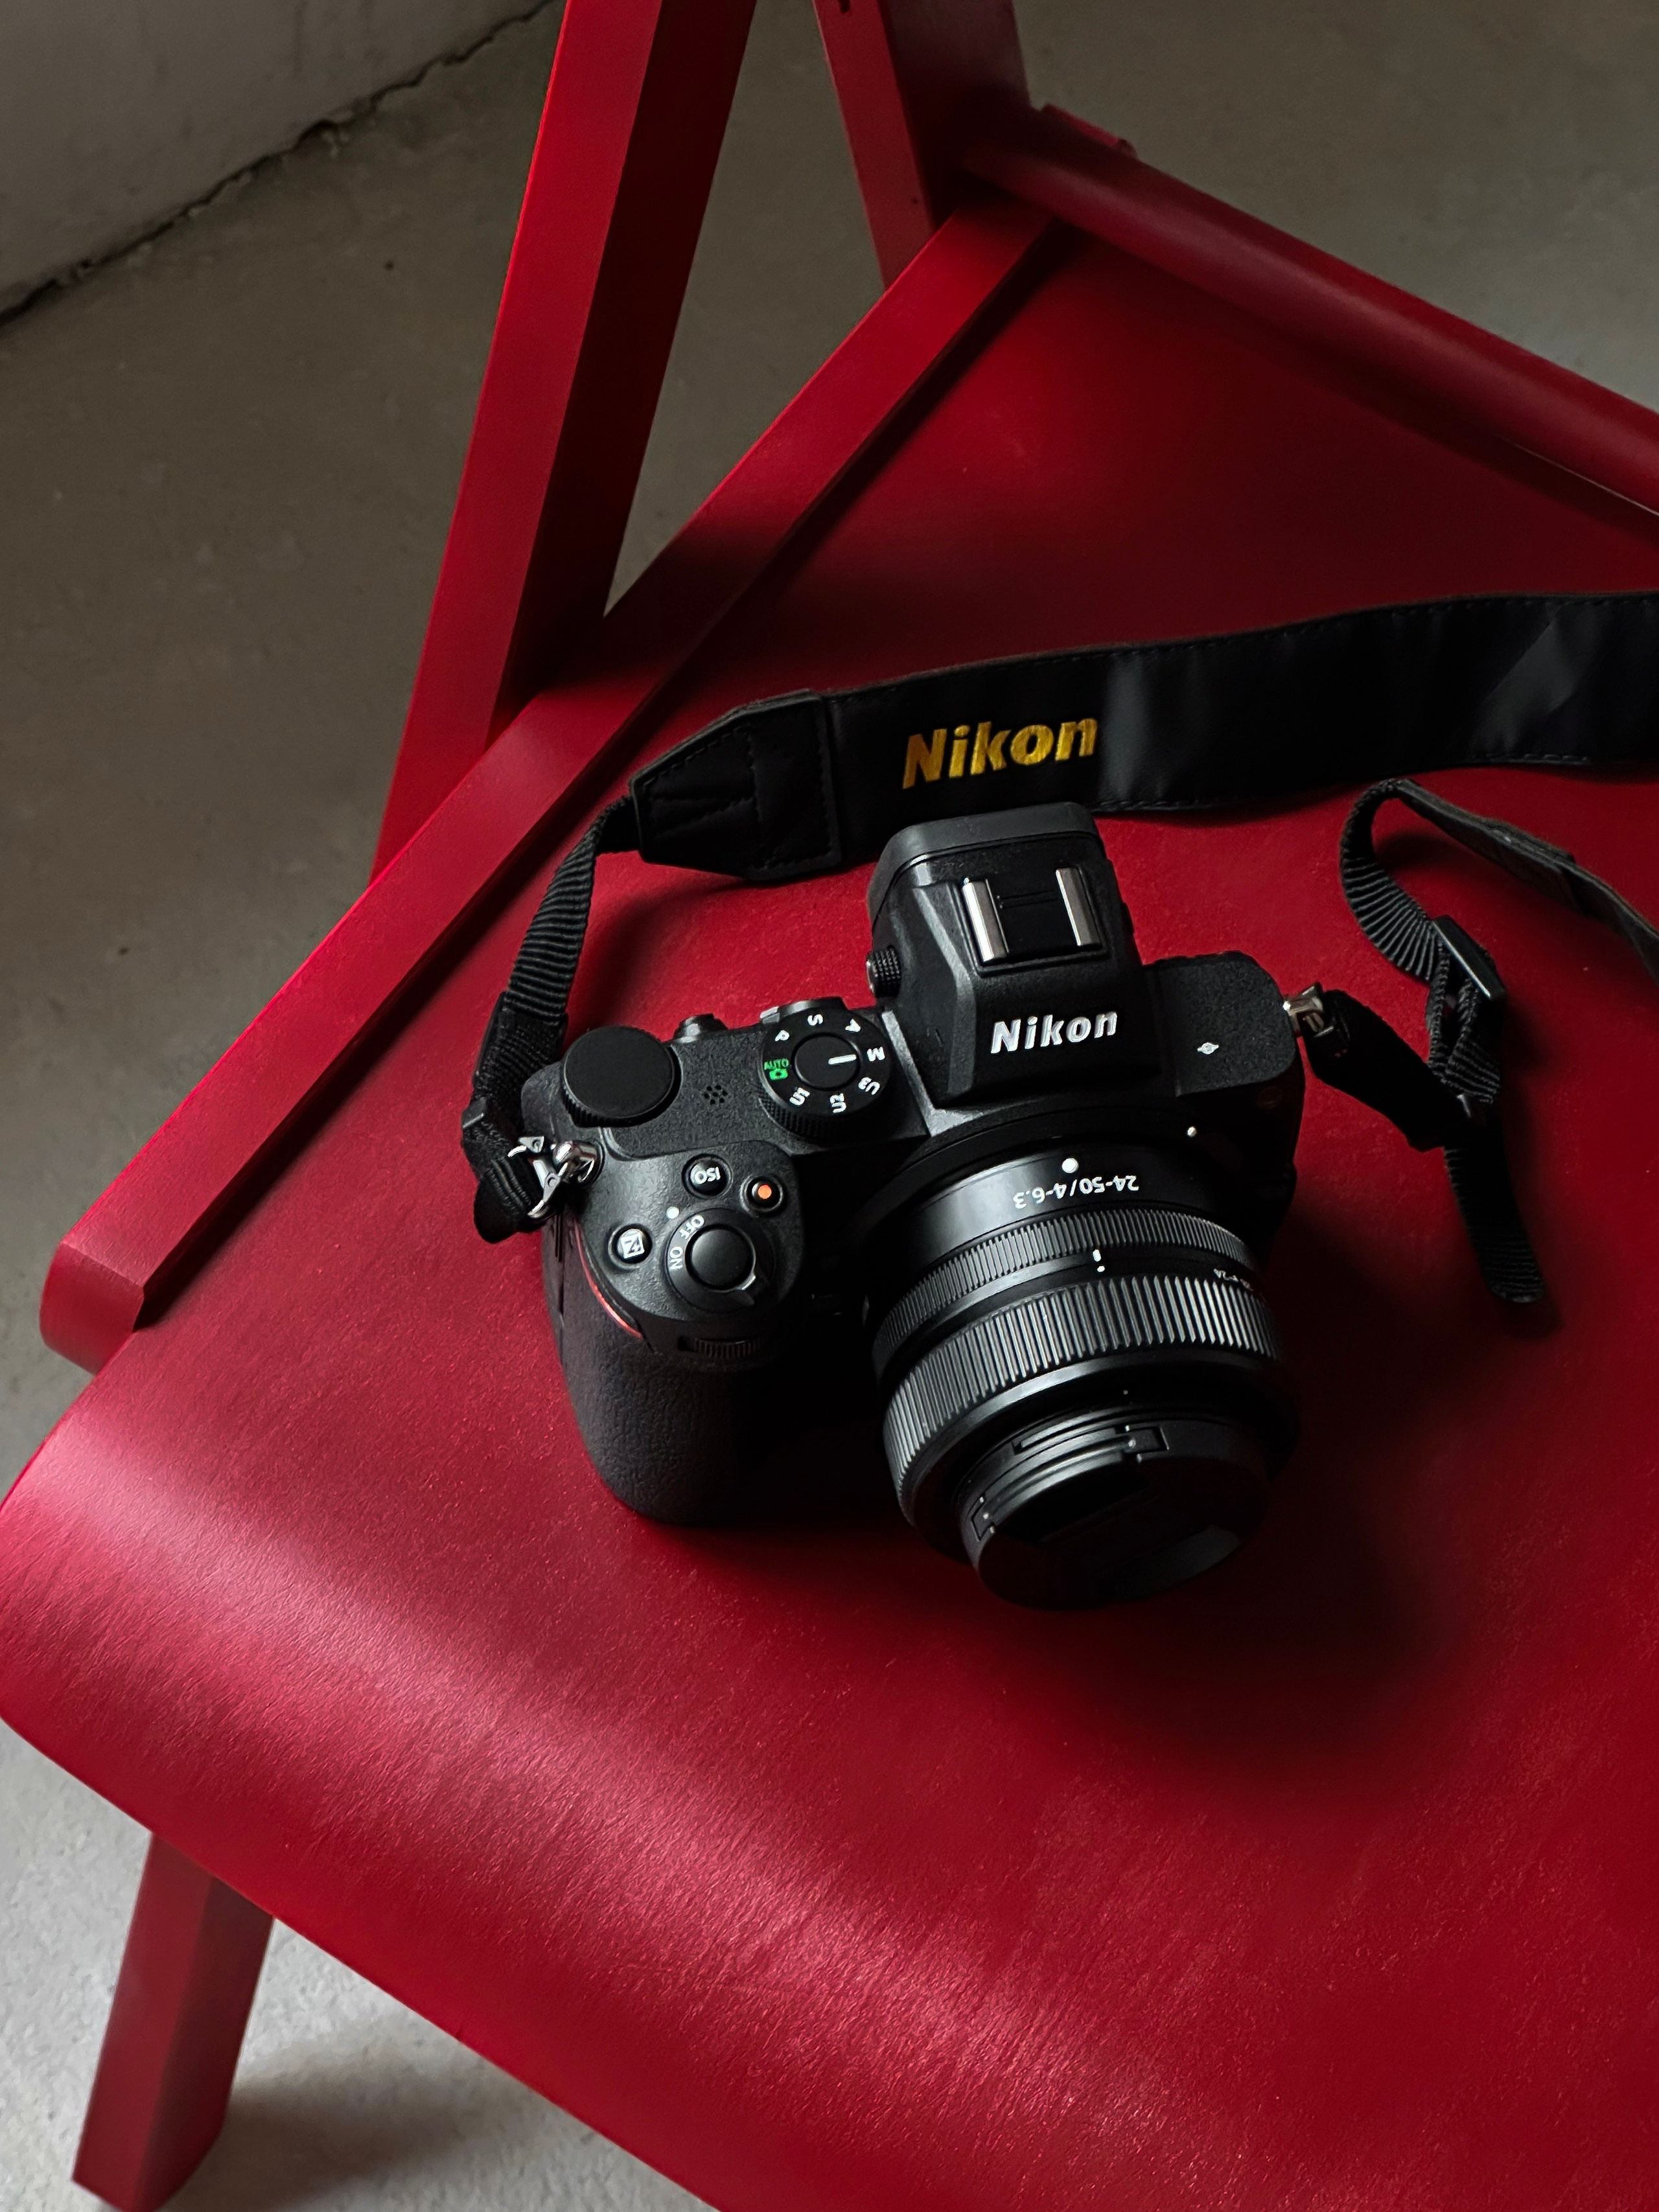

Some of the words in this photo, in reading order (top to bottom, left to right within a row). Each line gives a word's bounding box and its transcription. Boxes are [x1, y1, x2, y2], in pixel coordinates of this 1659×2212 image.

[903, 718, 1098, 789] Nikon
[807, 1013, 824, 1026] S
[845, 1019, 861, 1033] A
[774, 1030, 790, 1042] P
[991, 1011, 1117, 1054] Nikon
[866, 1046, 885, 1062] M
[764, 1057, 789, 1070] AUTO
[858, 1077, 880, 1095] U3
[830, 1093, 846, 1114] U2
[693, 1167, 721, 1184] ISO
[1013, 1175, 1139, 1209] 24-50/4-6.3
[679, 1215, 705, 1240] OFF
[669, 1246, 683, 1271] ON
